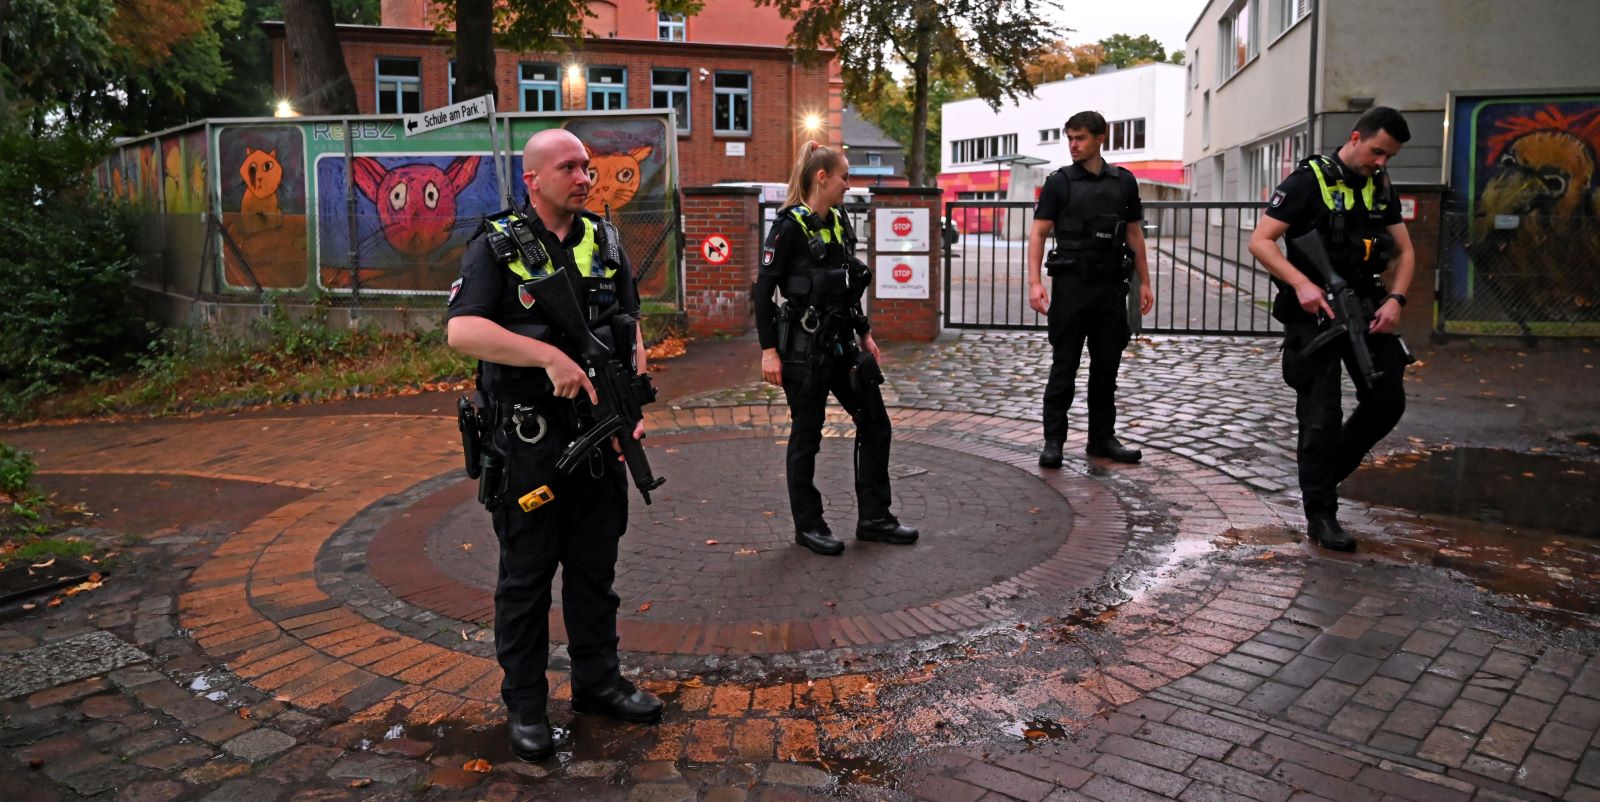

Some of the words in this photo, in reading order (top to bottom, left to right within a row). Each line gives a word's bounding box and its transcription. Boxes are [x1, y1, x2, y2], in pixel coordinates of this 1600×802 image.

[424, 112, 448, 128] Schule
[450, 112, 461, 121] am
[461, 103, 480, 118] Park
